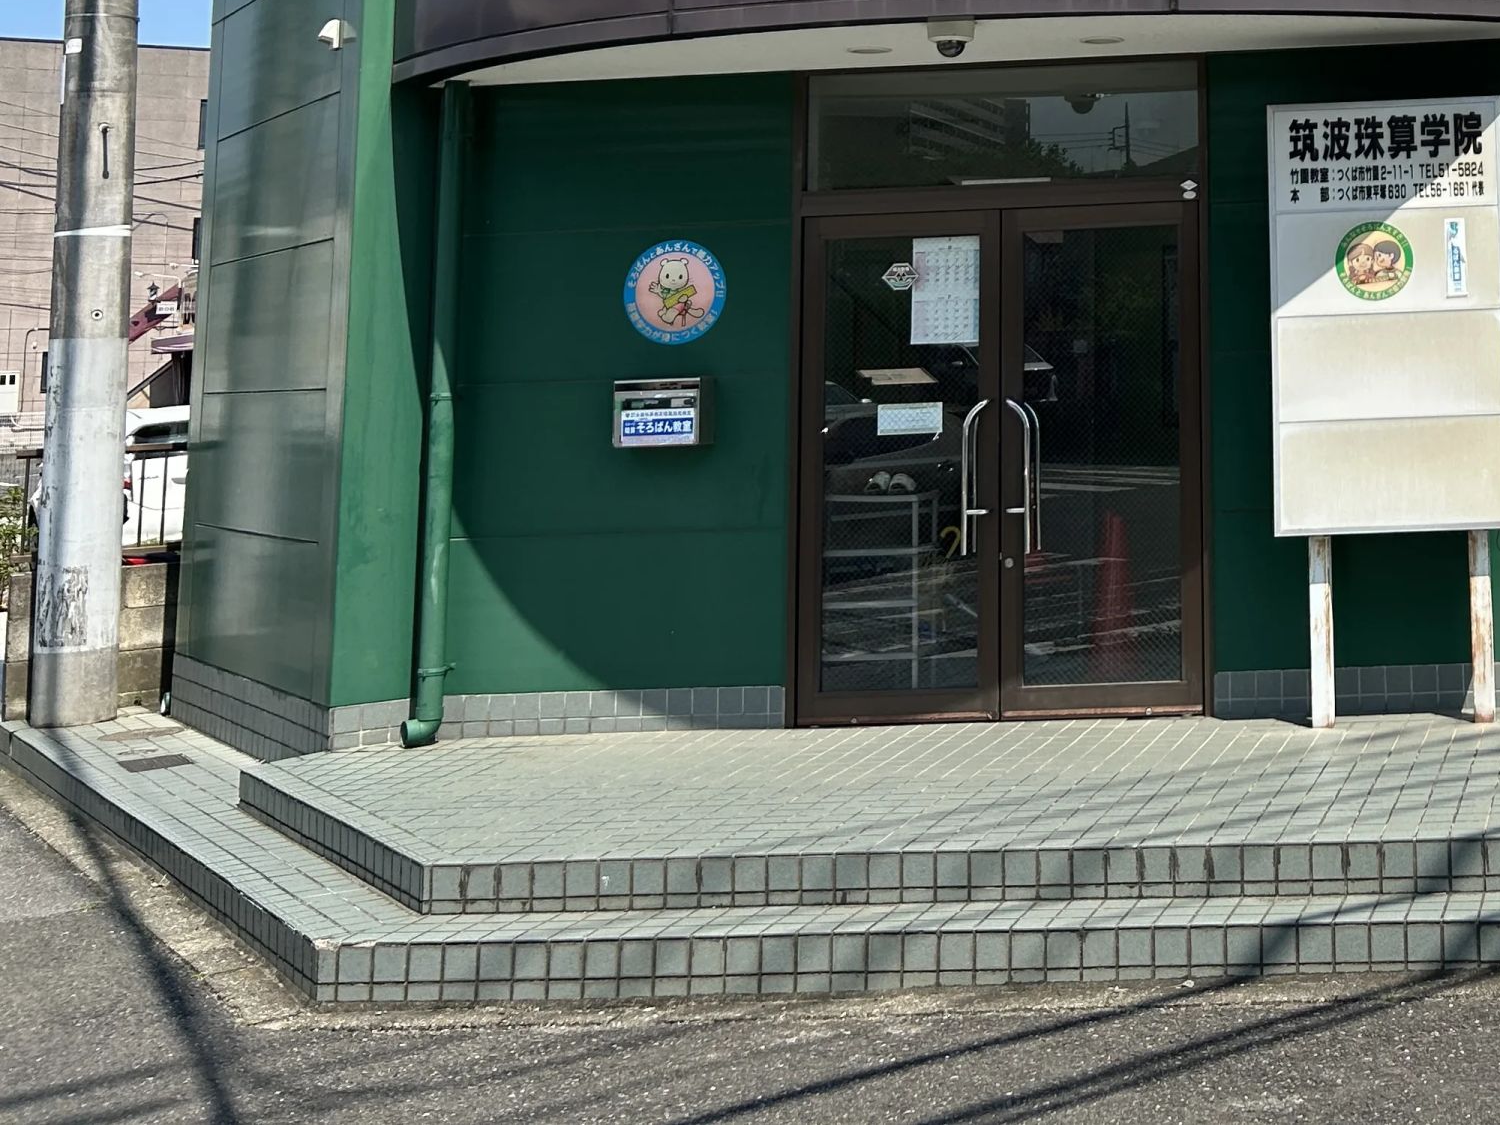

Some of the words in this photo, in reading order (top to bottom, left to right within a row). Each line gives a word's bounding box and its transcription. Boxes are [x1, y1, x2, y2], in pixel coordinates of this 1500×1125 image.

[1289, 112, 1483, 162] 筑波珠算学院
[636, 420, 692, 434] そろばん教室
